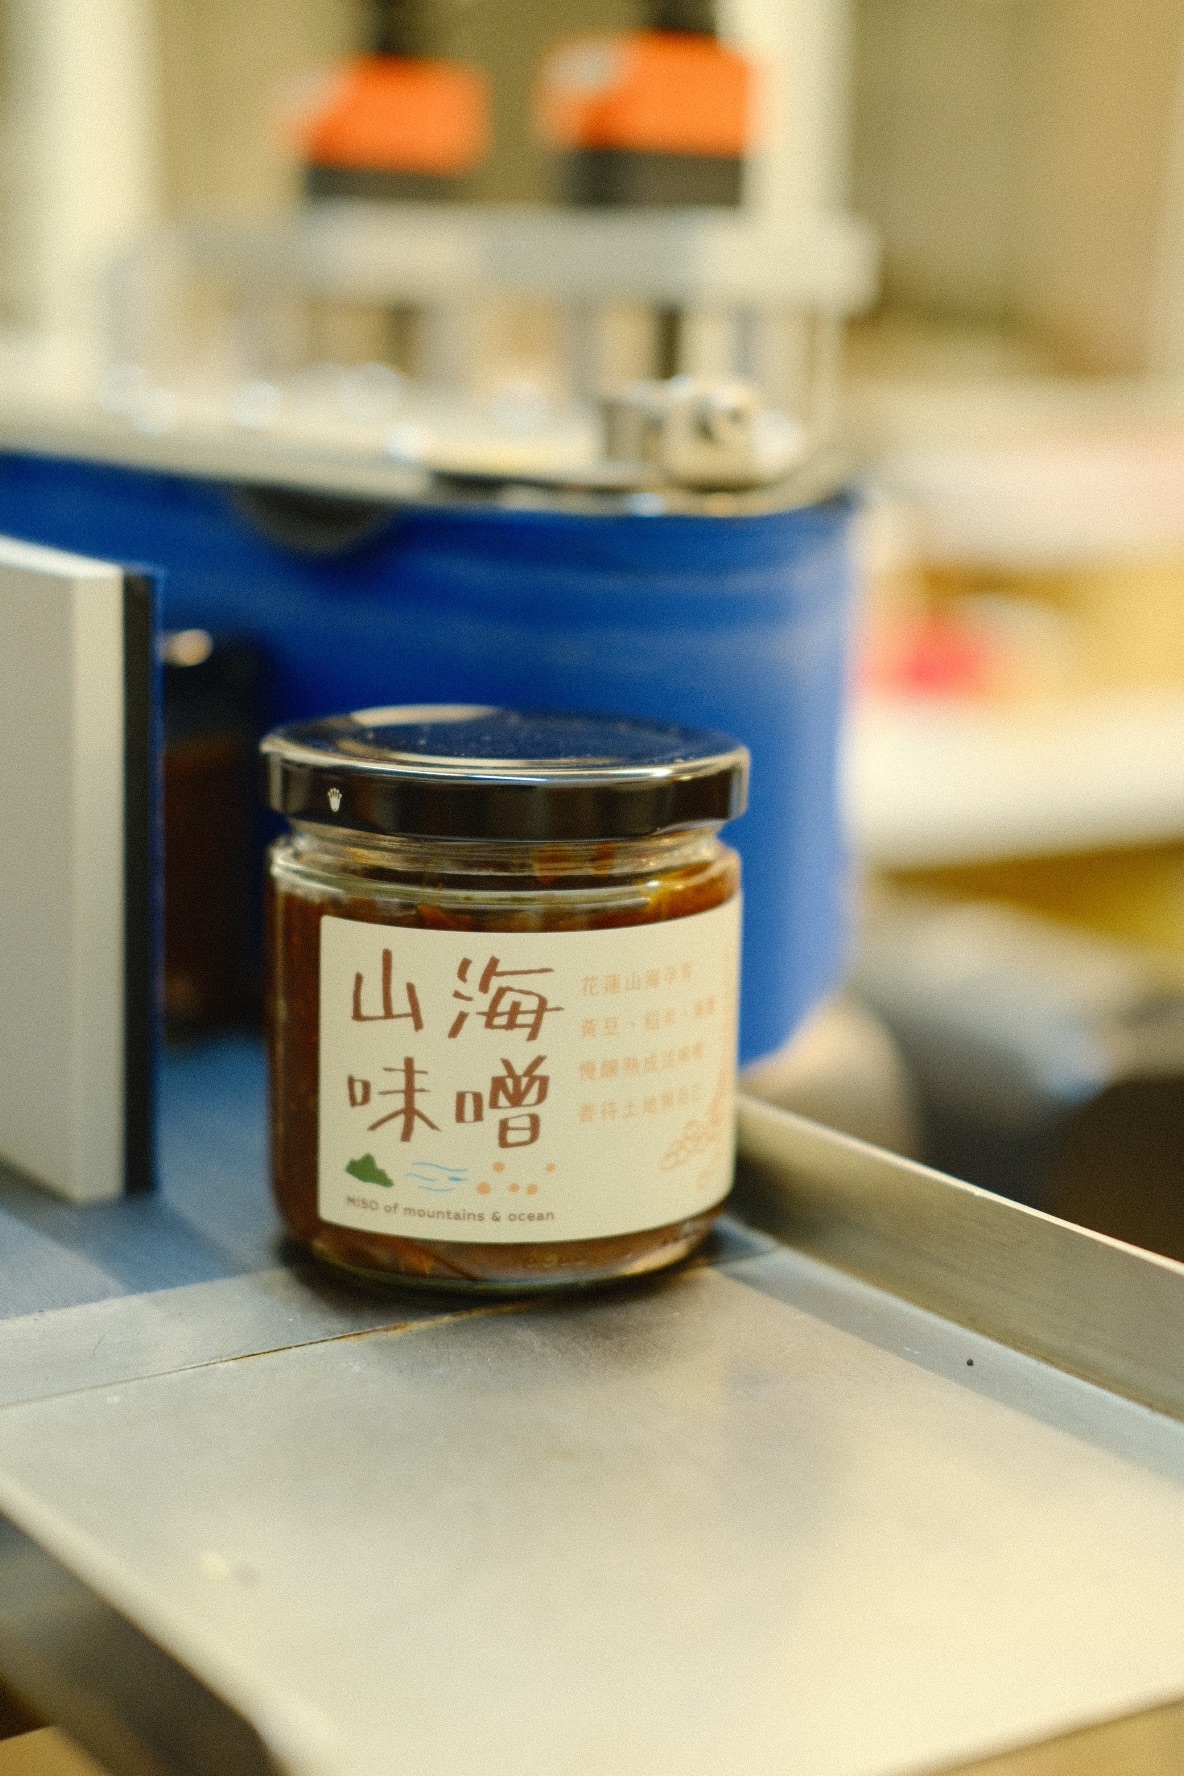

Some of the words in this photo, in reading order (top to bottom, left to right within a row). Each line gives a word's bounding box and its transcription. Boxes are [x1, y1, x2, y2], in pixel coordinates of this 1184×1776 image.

[351, 948, 564, 1041] 山海
[347, 1055, 551, 1149] 味噌
[346, 1196, 380, 1211] MISO
[384, 1203, 399, 1215] of
[403, 1207, 485, 1222] mountains
[491, 1211, 502, 1222] &
[508, 1211, 555, 1222] ocean
